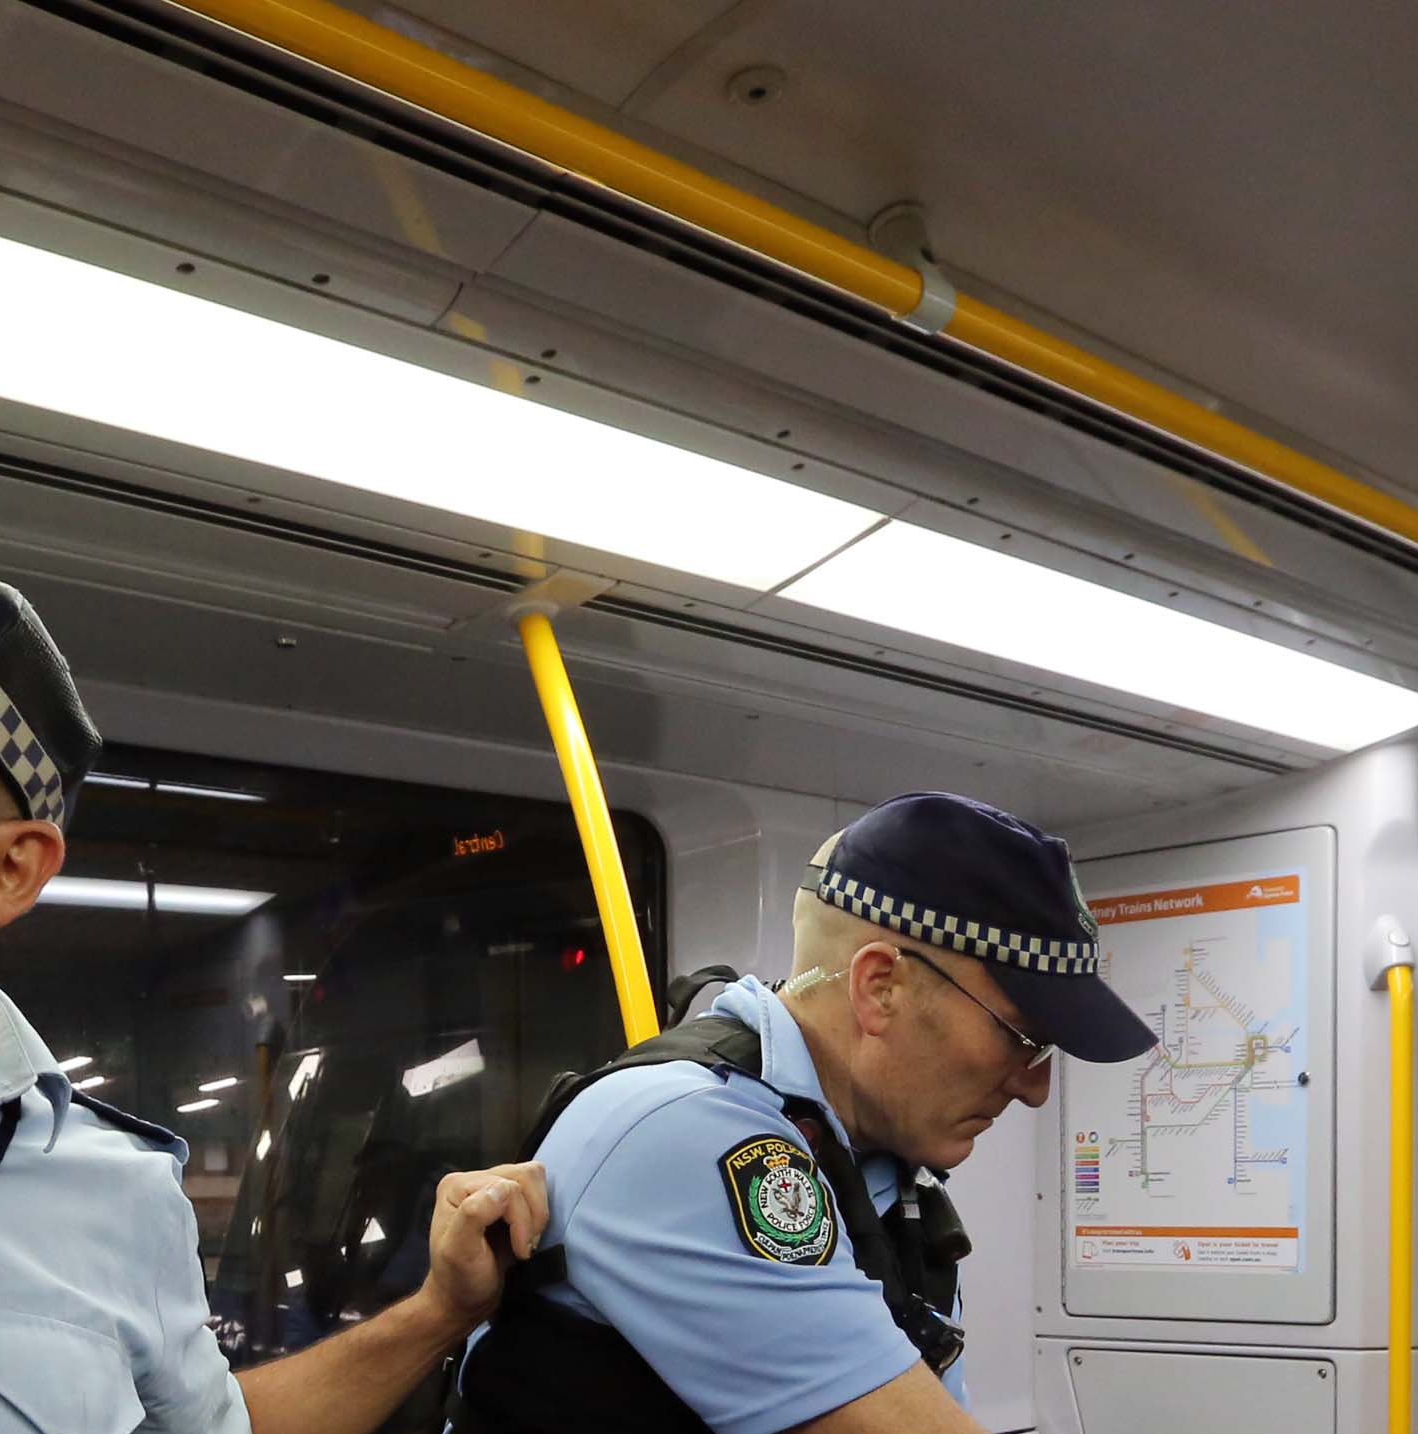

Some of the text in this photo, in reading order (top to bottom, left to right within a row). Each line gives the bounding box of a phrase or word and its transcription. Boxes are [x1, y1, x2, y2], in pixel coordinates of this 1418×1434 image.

[1118, 899, 1152, 915] Trains
[1153, 892, 1204, 912] Network
[760, 1168, 815, 1209] NEW SOUTH WALES
[767, 1212, 798, 1231] POLICE
